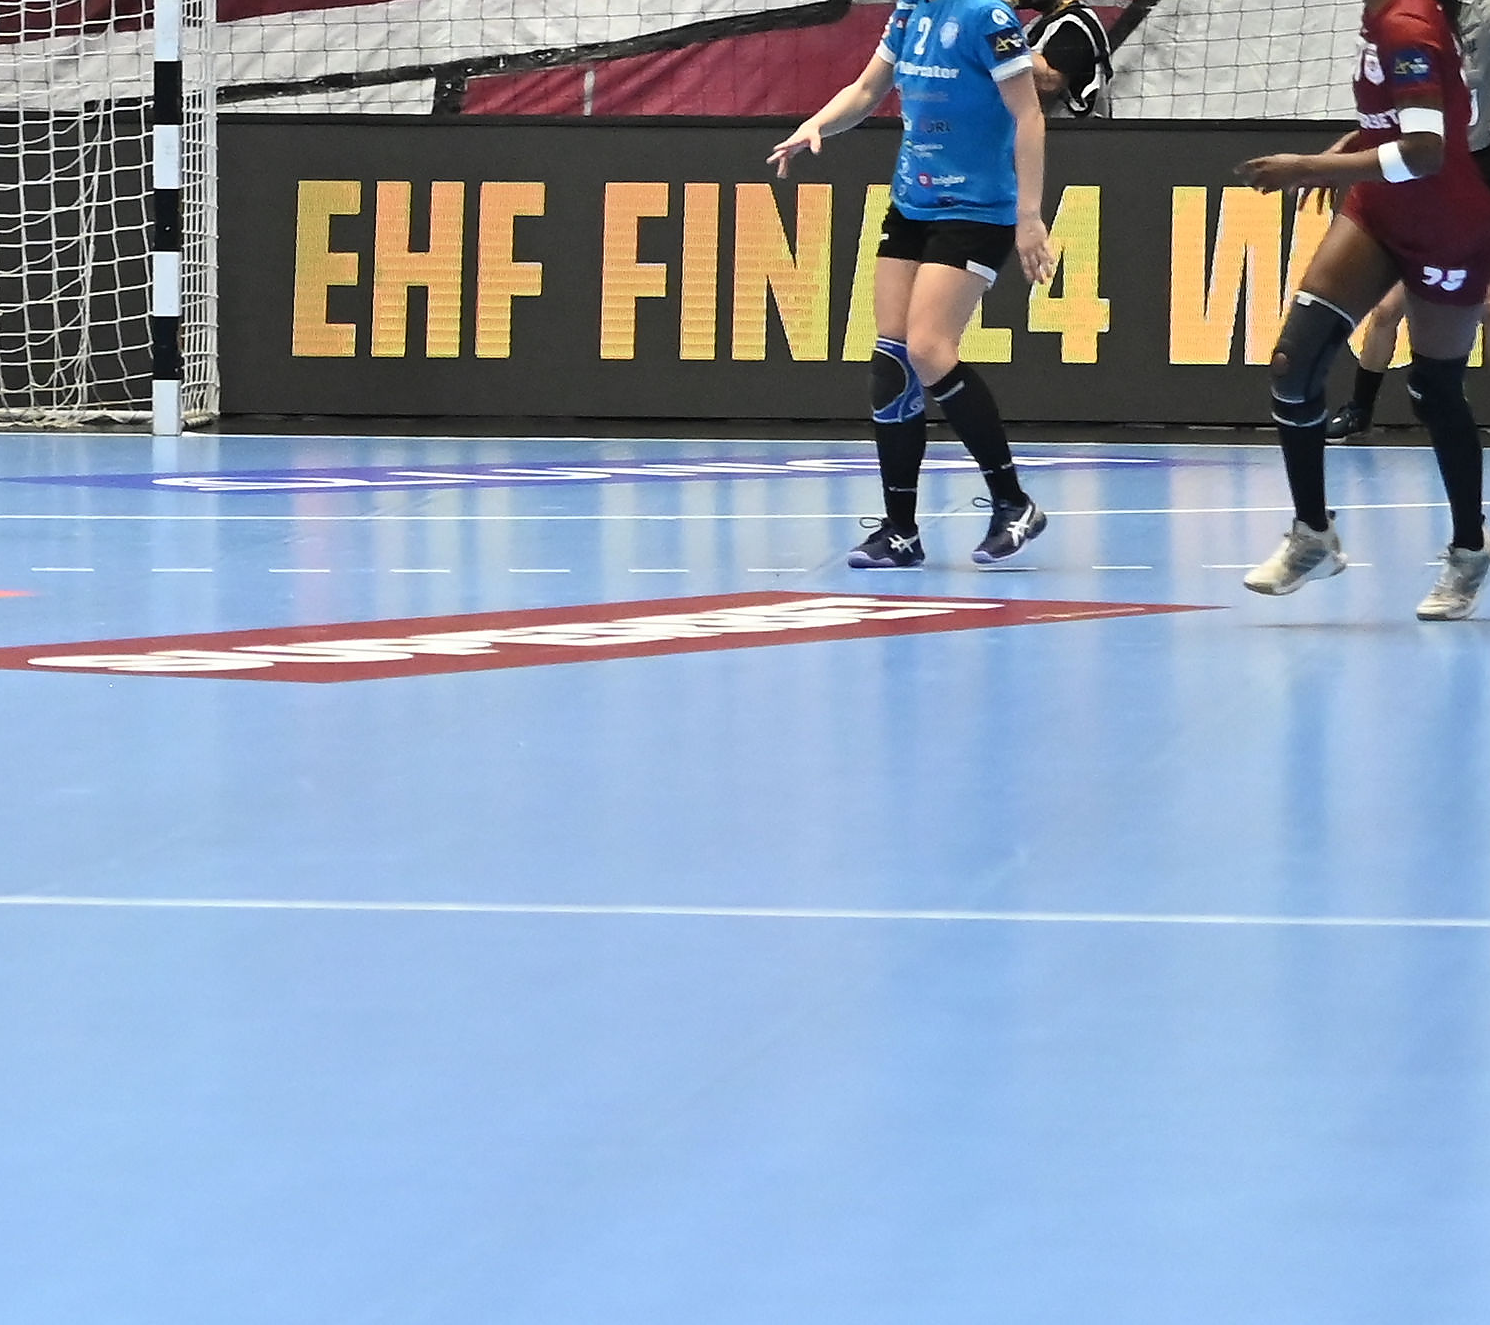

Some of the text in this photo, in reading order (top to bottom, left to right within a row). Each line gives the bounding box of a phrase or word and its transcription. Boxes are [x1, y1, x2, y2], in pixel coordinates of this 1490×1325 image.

[913, 16, 933, 56] 2
[291, 178, 547, 360] EHF
[600, 180, 1112, 366] FIN4
[26, 596, 1009, 675] SUPERBET
